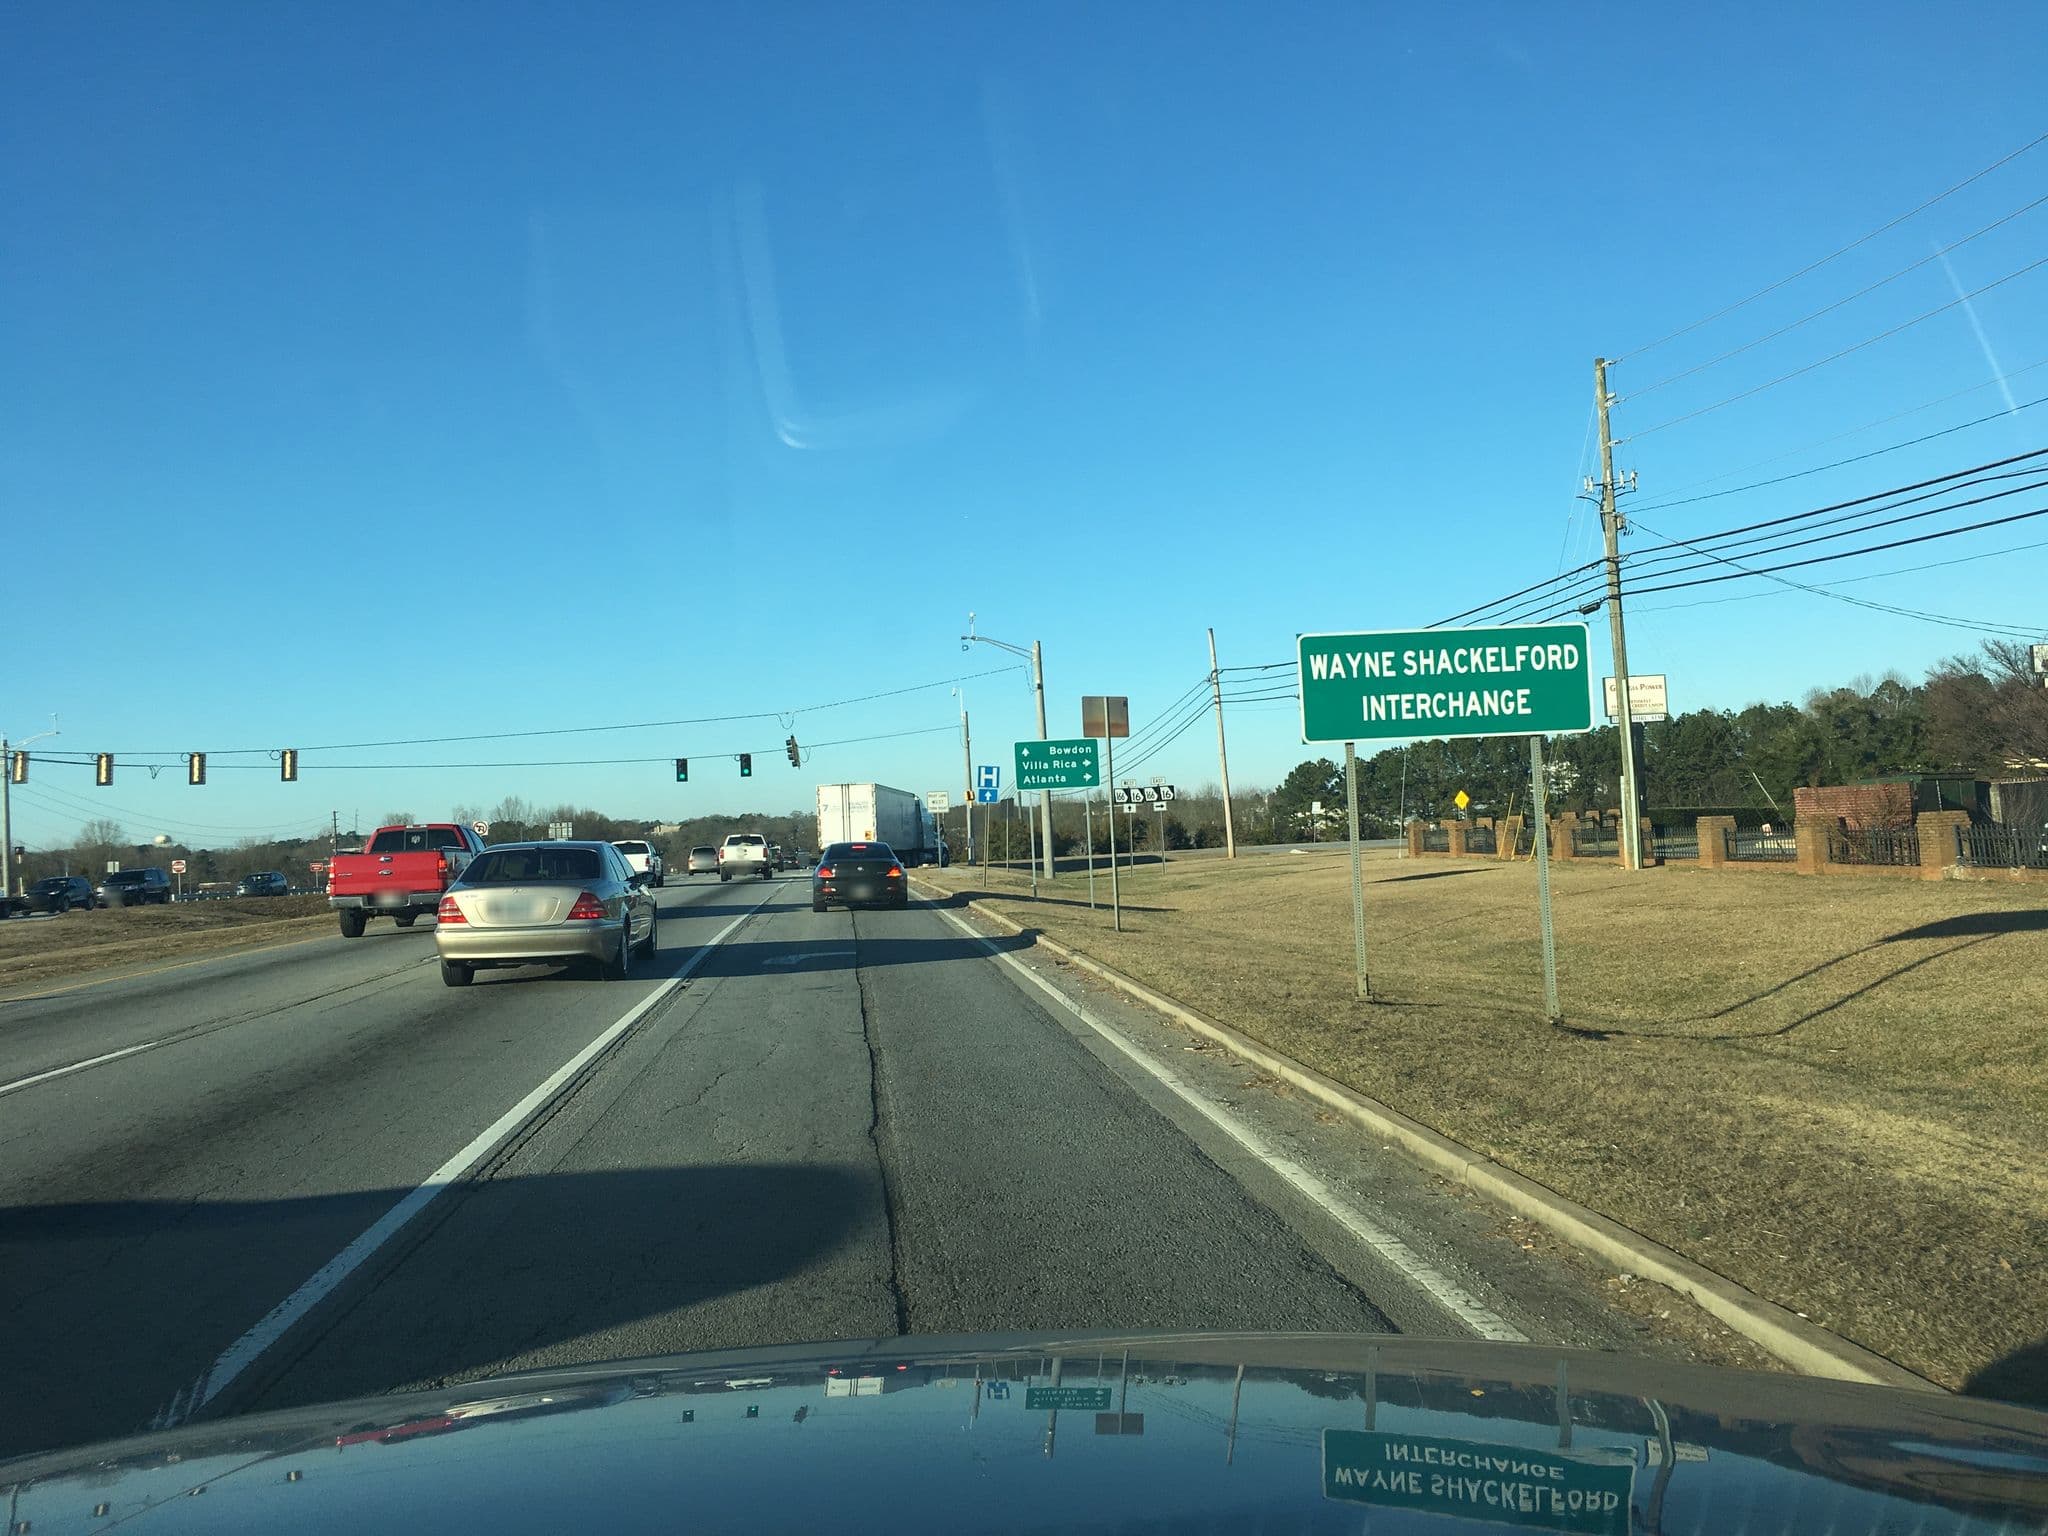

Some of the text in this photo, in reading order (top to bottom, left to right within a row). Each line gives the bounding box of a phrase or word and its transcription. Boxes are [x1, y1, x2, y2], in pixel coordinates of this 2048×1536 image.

[1309, 643, 1580, 681] WAYNE SHACKELFORD
[1362, 688, 1532, 722] INTERCHANGE
[1049, 746, 1092, 755] Bowdon
[1022, 760, 1077, 770] Villa Rica
[980, 767, 998, 787] H
[1023, 774, 1067, 784] Atlanta
[1116, 792, 1126, 801] 166
[1132, 792, 1141, 801] 16
[1145, 791, 1155, 800] 166
[1162, 790, 1171, 799] 16
